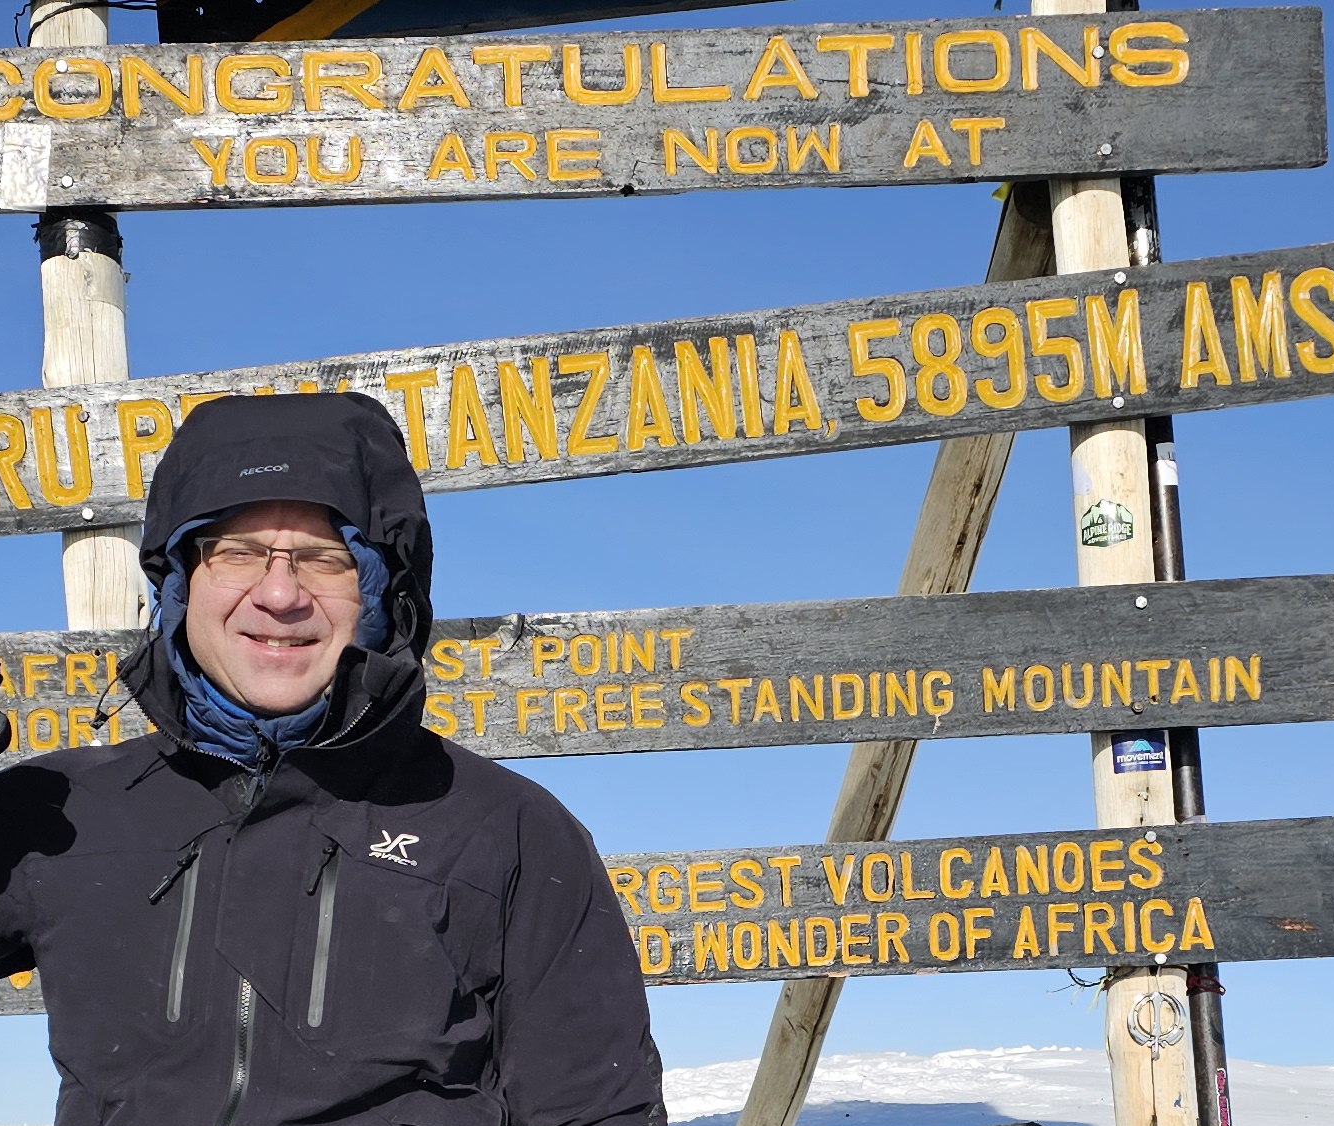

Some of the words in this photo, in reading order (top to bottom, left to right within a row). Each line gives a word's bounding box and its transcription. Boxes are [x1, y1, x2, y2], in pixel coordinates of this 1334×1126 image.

[191, 135, 363, 188] YOU
[426, 127, 603, 182] ARE
[663, 122, 841, 176] NOW
[903, 116, 1006, 168] AT
[847, 288, 1148, 422] 5895M
[430, 638, 501, 680] ST
[532, 629, 692, 678] POINT
[425, 690, 496, 738] ST
[516, 682, 666, 735] FREE
[679, 668, 954, 727] STANDING
[982, 653, 1262, 713] MOUNTAIN
[607, 856, 801, 915] RGEST
[823, 838, 1165, 906] VOLCANOES
[694, 912, 910, 973] WONDER
[928, 907, 995, 962] OF
[1012, 897, 1216, 960] AFRICA
